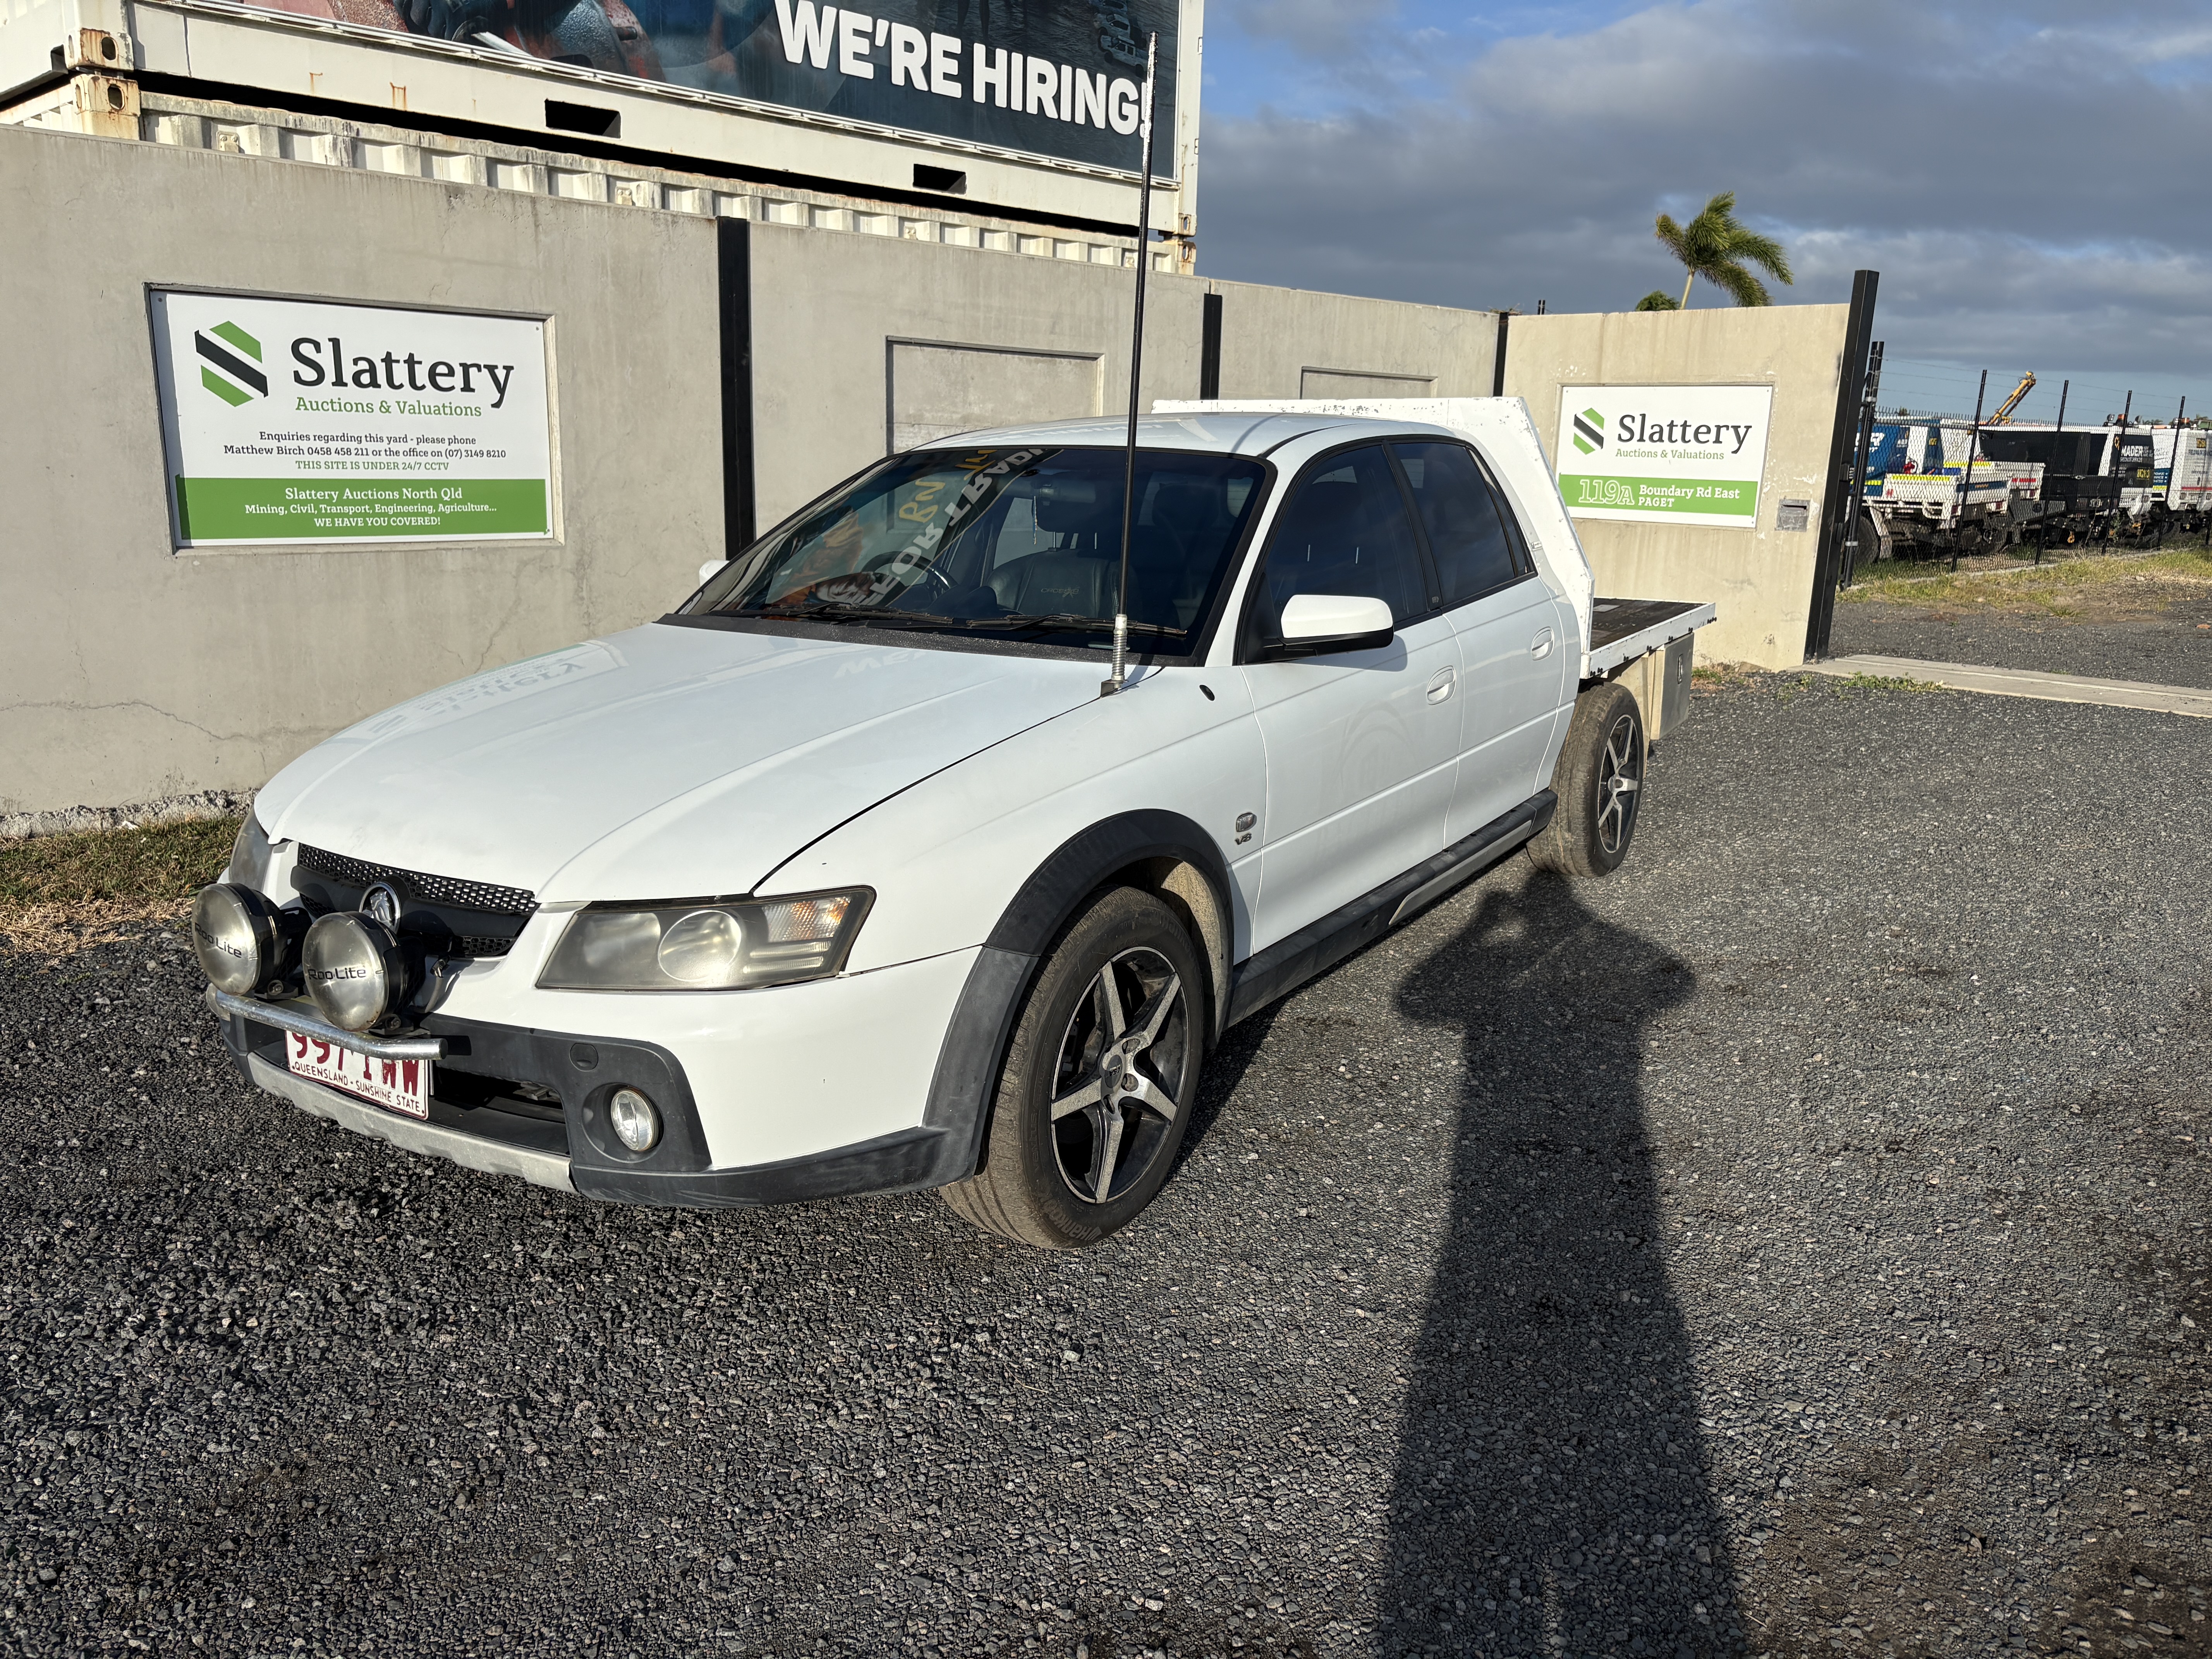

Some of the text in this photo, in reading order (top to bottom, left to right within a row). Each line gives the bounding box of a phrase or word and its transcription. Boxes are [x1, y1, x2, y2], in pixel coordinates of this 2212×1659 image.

[775, 0, 962, 98] WE'RE
[291, 338, 514, 409] Slattery
[295, 397, 481, 416] Auctions & Valuations
[259, 432, 310, 442] Enquiries
[313, 433, 362, 444] regarding
[365, 433, 384, 443] this
[386, 434, 408, 445] yard
[416, 434, 445, 445] please
[448, 435, 476, 446] phone
[1616, 414, 1752, 458] Slattery
[1618, 414, 1752, 454] Auctions
[224, 445, 273, 454] Matthew
[276, 446, 304, 455] Birch
[307, 447, 331, 455] 0458
[354, 448, 369, 456] 211
[385, 447, 400, 456] the
[403, 448, 428, 457] office
[445, 448, 462, 459] (07)
[1671, 449, 1724, 459] Valuations
[295, 461, 321, 469] THIS
[324, 461, 347, 469] SITE
[362, 462, 400, 470] UNDER
[402, 461, 422, 471] 24/7
[285, 488, 462, 502] Slattery Auctions North Qld
[1578, 479, 1635, 505] 119A
[1639, 485, 1740, 499] Boundary Rd East
[245, 503, 496, 515] Mining, Civil, Transport, Engineering, Agriculture...
[1638, 497, 1674, 507] PAGET
[314, 518, 332, 527] WE
[335, 518, 364, 526] HAVE
[390, 517, 440, 526] COVERED!
[294, 1061, 420, 1112] QUEENSLAND SUNSHINE STATE
